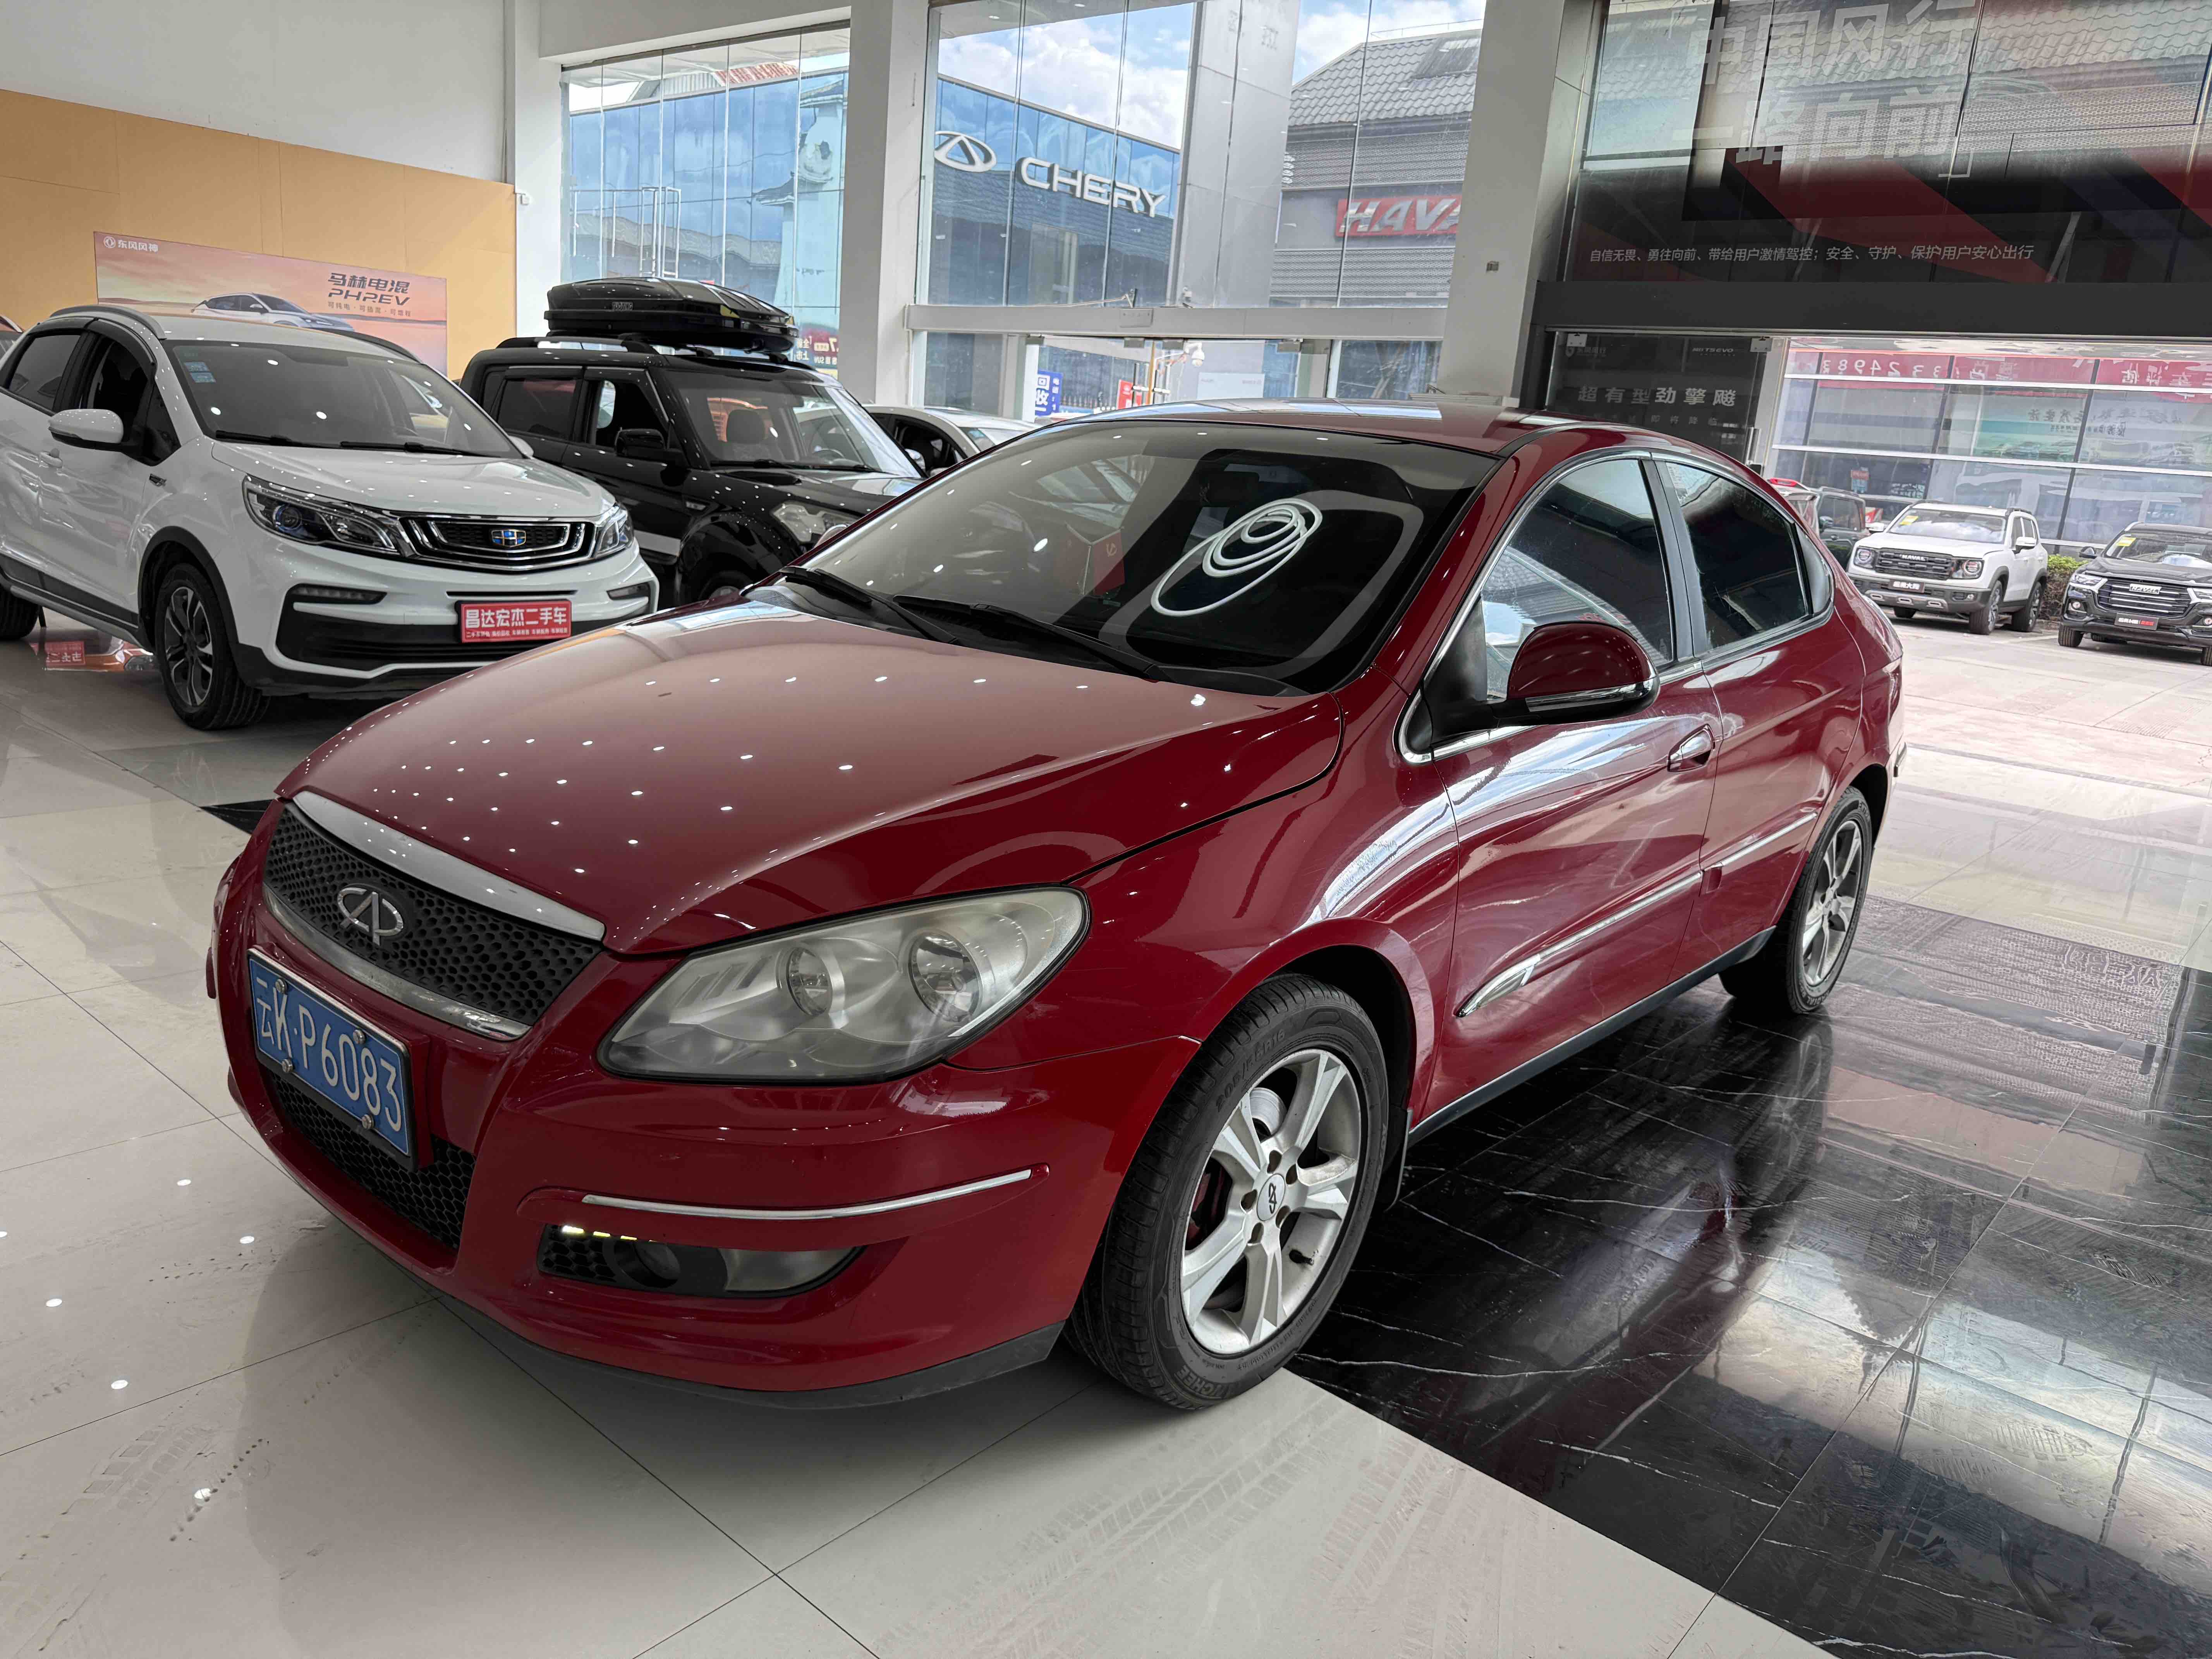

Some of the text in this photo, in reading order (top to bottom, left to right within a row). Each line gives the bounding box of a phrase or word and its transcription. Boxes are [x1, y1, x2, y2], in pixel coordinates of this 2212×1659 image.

[1021, 157, 1166, 218] CHERY
[117, 240, 158, 252] 东风风神
[328, 288, 410, 306] PHREV
[465, 607, 567, 628] 昌达宏杰二手车
